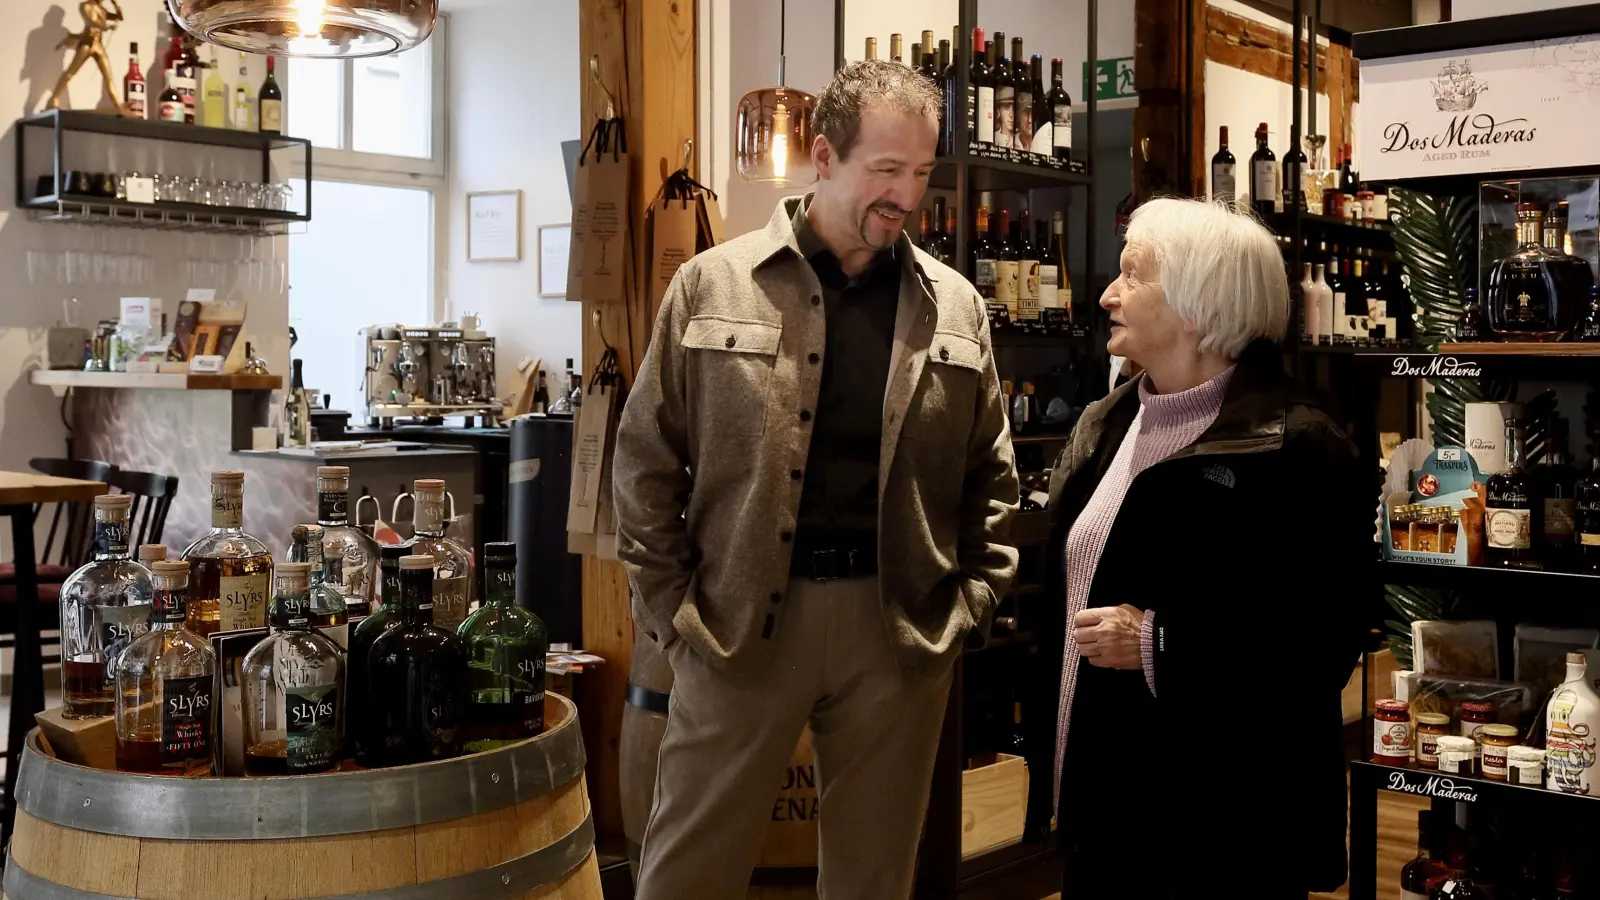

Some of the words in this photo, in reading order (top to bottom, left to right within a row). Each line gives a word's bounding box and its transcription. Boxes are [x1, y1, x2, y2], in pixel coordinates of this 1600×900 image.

[1380, 121, 1429, 153] Dos
[1432, 114, 1537, 149] Maderas
[1422, 152, 1457, 162] AGED
[1460, 149, 1491, 160] RUM
[1391, 357, 1420, 376] Dos
[1420, 357, 1482, 377] Maderas
[220, 501, 243, 515] SLYR
[424, 507, 444, 521] SLYR
[105, 526, 130, 542] SLYR
[1432, 557, 1456, 565] STORY?
[497, 572, 516, 586] SLYR
[162, 593, 188, 609] SLYR
[226, 587, 263, 612] SLYRS
[284, 598, 310, 614] SLYR
[433, 590, 464, 611] SLYRS
[109, 618, 149, 643] SLYRS
[517, 654, 545, 678] SLYRS
[170, 691, 210, 717] SLYRS
[292, 698, 333, 726] SLYRS
[176, 728, 203, 739] Whisky
[1387, 771, 1417, 793] Dos
[1417, 776, 1479, 803] Maderas
